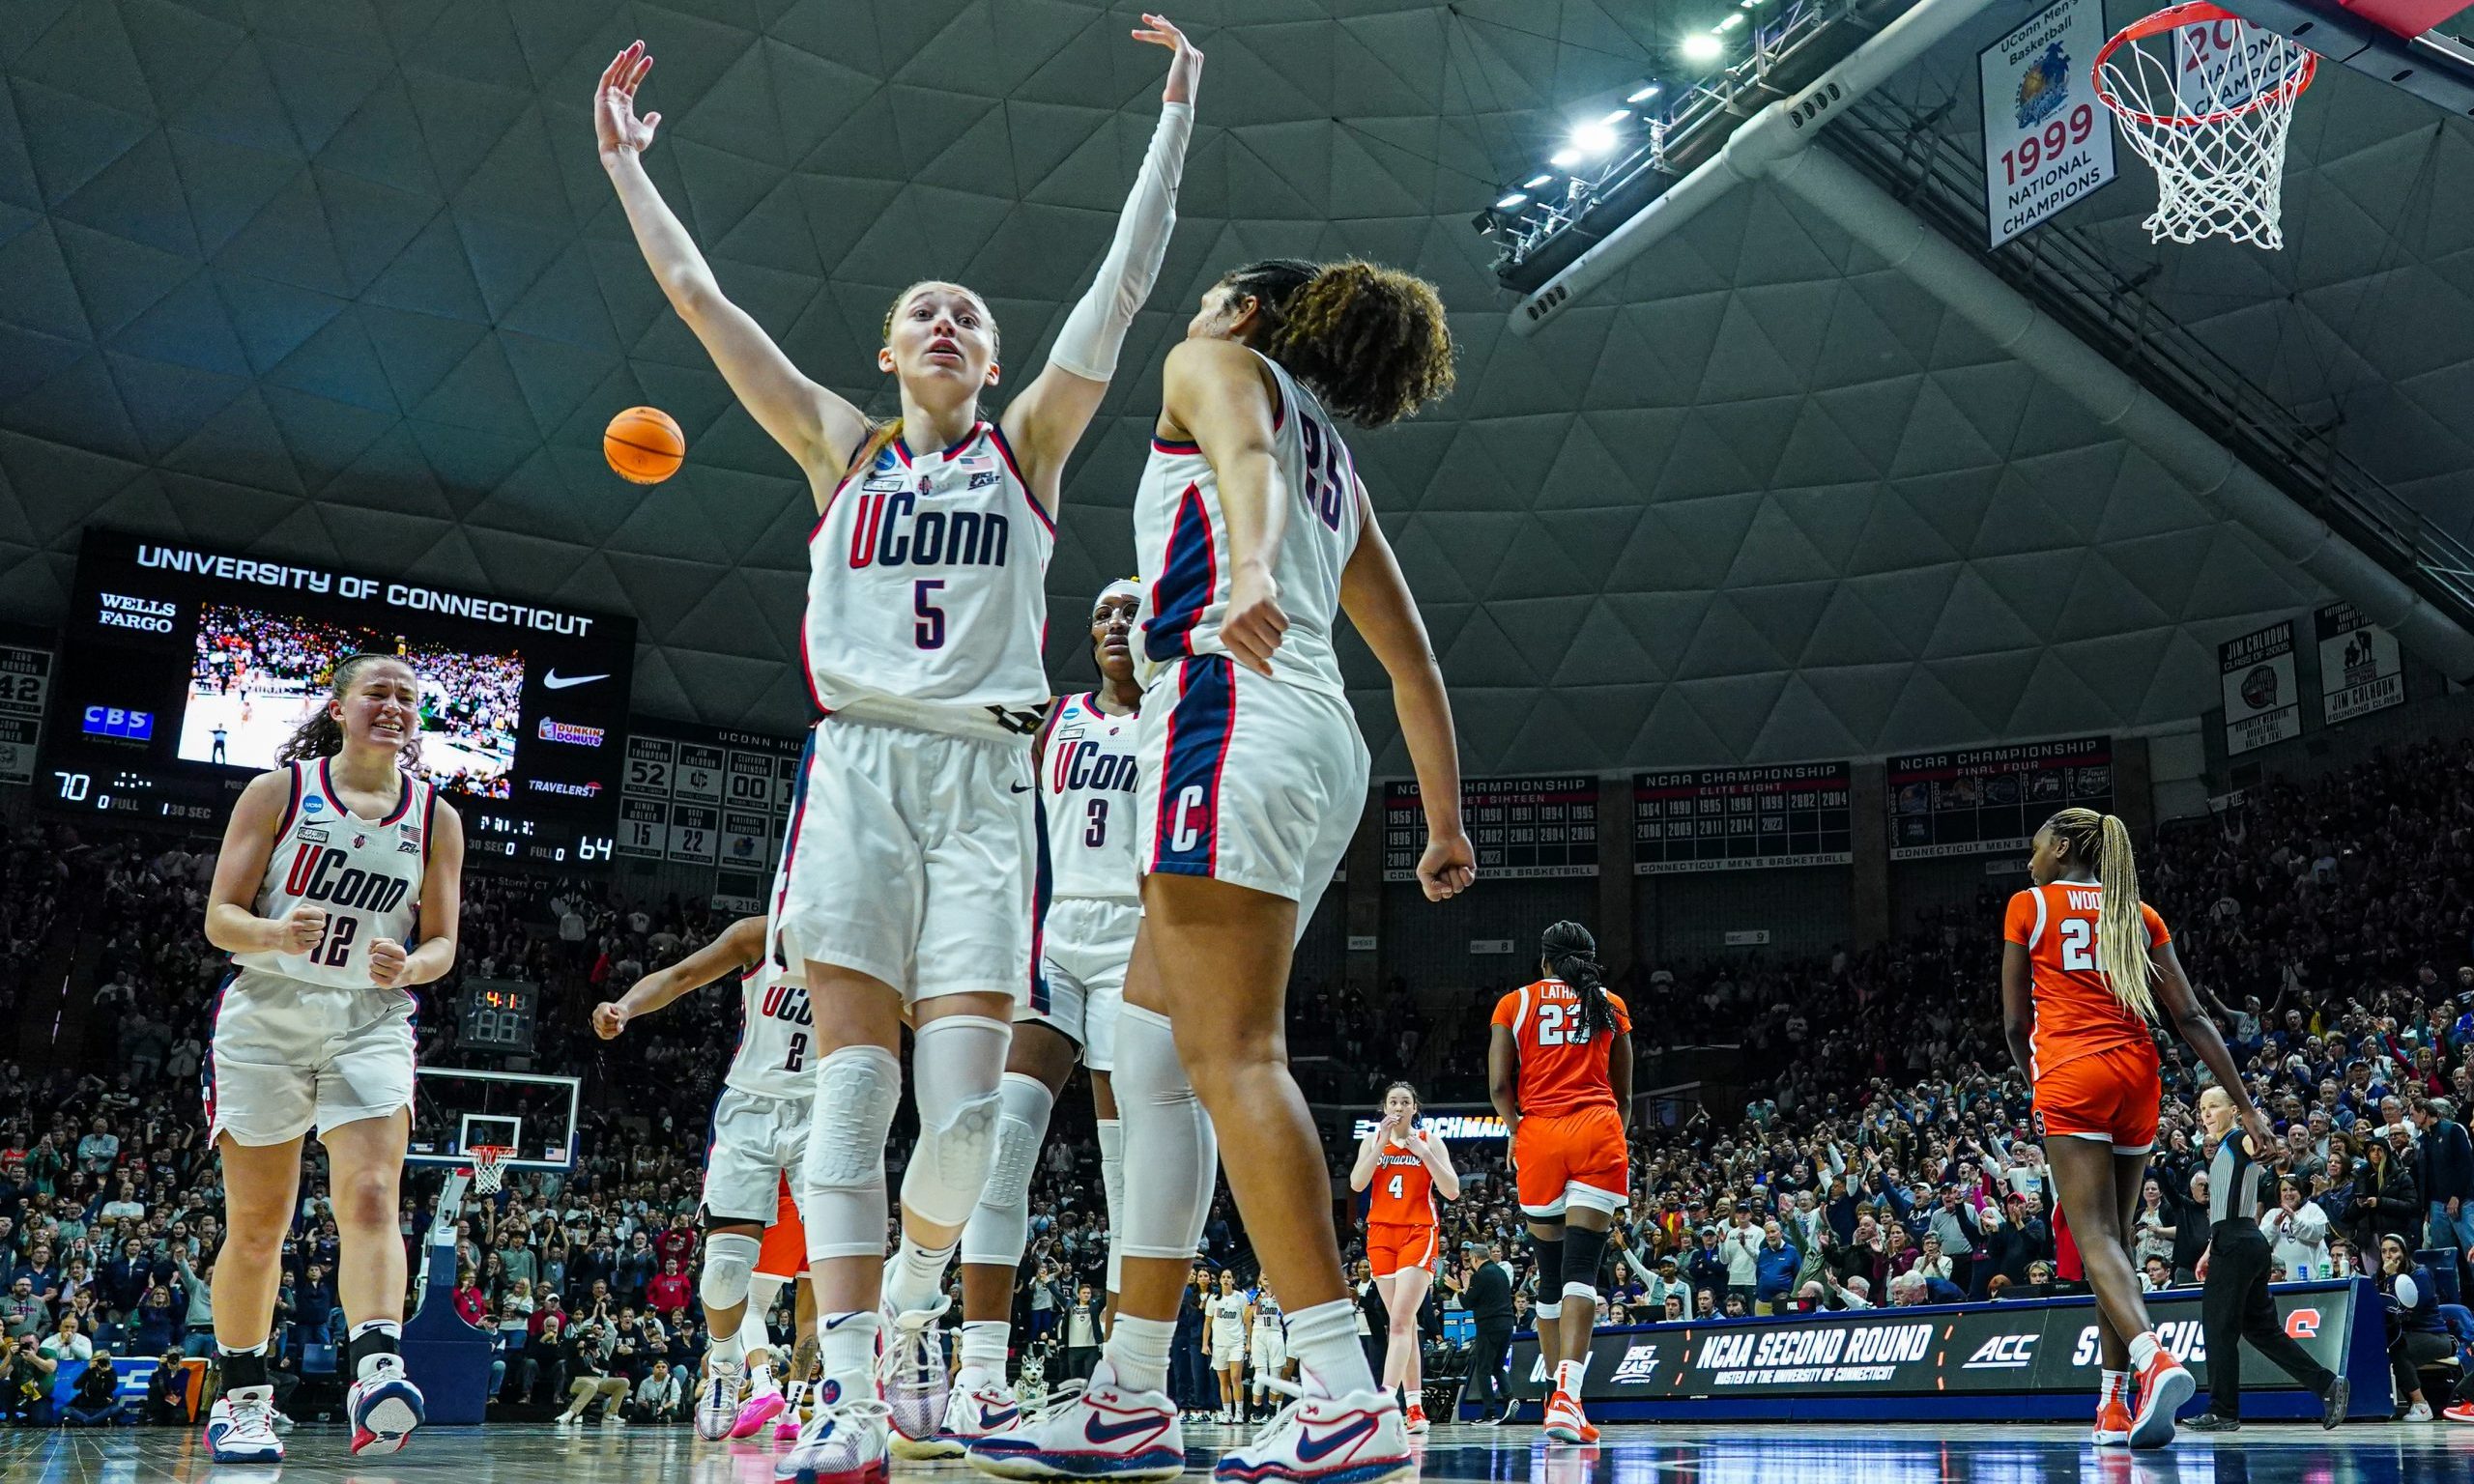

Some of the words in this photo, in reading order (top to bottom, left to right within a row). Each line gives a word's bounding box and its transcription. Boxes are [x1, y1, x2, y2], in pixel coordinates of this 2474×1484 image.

[2000, 20, 2040, 53] UConn
[2009, 15, 2072, 66] Basketball
[2185, 19, 2248, 72] 20
[2200, 33, 2279, 90] NATION
[2195, 45, 2299, 116] CHAMPION
[2000, 103, 2093, 186] 1999
[2008, 151, 2092, 210] NATIONAL
[2002, 167, 2100, 235] CHAMPIONS
[1299, 410, 1342, 532] 25
[849, 491, 1009, 570] UConn
[137, 545, 331, 594] UNIVERSITY
[338, 576, 379, 600] OF
[387, 584, 593, 638] CONNECTICUT
[100, 592, 176, 617] WELLS
[914, 580, 945, 650] 5
[99, 610, 173, 634] FARGO
[2228, 639, 2244, 660] JIM
[2246, 623, 2289, 653] CALHOUN
[0, 676, 40, 702] 42
[2333, 693, 2348, 711] JIM
[2352, 677, 2395, 704] CALHOUN
[85, 705, 148, 728] CBS
[557, 732, 603, 746] DONUTS
[558, 724, 604, 736] DUNKIN'
[719, 731, 771, 747] UCONN
[1054, 740, 1140, 795] UCon
[1900, 756, 1947, 771] NCAA
[1957, 740, 2097, 765] CHAMPIONSHIP
[631, 761, 665, 786] 52
[1646, 774, 1692, 787] NCAA
[1702, 765, 1837, 785] CHAMPIONSHIP
[1957, 765, 1995, 777] FINAL
[2003, 760, 2039, 772] FOUR
[55, 771, 90, 801] 70
[529, 780, 590, 797] TRAVELERS
[733, 776, 766, 799] 00
[1397, 785, 1418, 795] NC
[1700, 785, 1736, 795] ELITE
[1743, 783, 1782, 793] EIGHT
[98, 795, 110, 810] 0
[111, 797, 139, 812] FULL
[170, 804, 186, 816] 30
[187, 806, 212, 819] SEC
[1511, 807, 1532, 821] 1991
[1541, 806, 1564, 819] 1994
[1572, 805, 1595, 819] 1995
[1700, 798, 1721, 813] 1995
[1761, 795, 1784, 810] 1999
[1791, 793, 1816, 809] 2002
[1822, 791, 1847, 807] 2004
[633, 822, 651, 846] 15
[1085, 798, 1108, 848] 3
[1480, 829, 1504, 843] 2002
[1510, 828, 1535, 842] 2003
[1540, 827, 1565, 841] 2004
[1700, 820, 1722, 835] 2011
[1730, 819, 1754, 834] 2014
[1762, 817, 1783, 832] 2023
[484, 840, 503, 851] SEC
[505, 842, 515, 856] 0
[530, 846, 553, 859] FULL
[555, 848, 564, 862] 0
[579, 836, 613, 861] 64
[682, 830, 705, 853] 22
[1896, 843, 1980, 858] CONNECTICUT
[1516, 866, 1593, 877] BASKETBALL
[1640, 862, 1721, 874] CONNECTICUT
[1769, 854, 1847, 867] BASKETBALL
[285, 843, 409, 913] UConn
[735, 899, 759, 912] 216
[2066, 890, 2102, 911] WOO
[1501, 942, 1509, 952] 8
[1757, 931, 1764, 942] 9
[2059, 918, 2107, 972] 2
[1540, 985, 1577, 999] LATHA
[762, 986, 814, 1027] UCo
[785, 1032, 808, 1072] 2
[1376, 1152, 1422, 1169] Syracuse
[1388, 1175, 1403, 1199] 4
[1624, 1345, 1657, 1360] BIG
[1696, 1333, 1756, 1369] NCAA
[1753, 1328, 1847, 1367] SECOND
[1843, 1324, 1934, 1363] ROUND
[1969, 1335, 2039, 1362] ACC
[1616, 1359, 1660, 1376] EAST
[1714, 1371, 1746, 1385] HOSTED
[1744, 1370, 1759, 1384] BY
[1757, 1369, 1775, 1384] THE
[1772, 1367, 1824, 1384] UNIVERSITY
[1821, 1367, 1836, 1382] OF
[1833, 1365, 1896, 1382] CONNECTICUT
